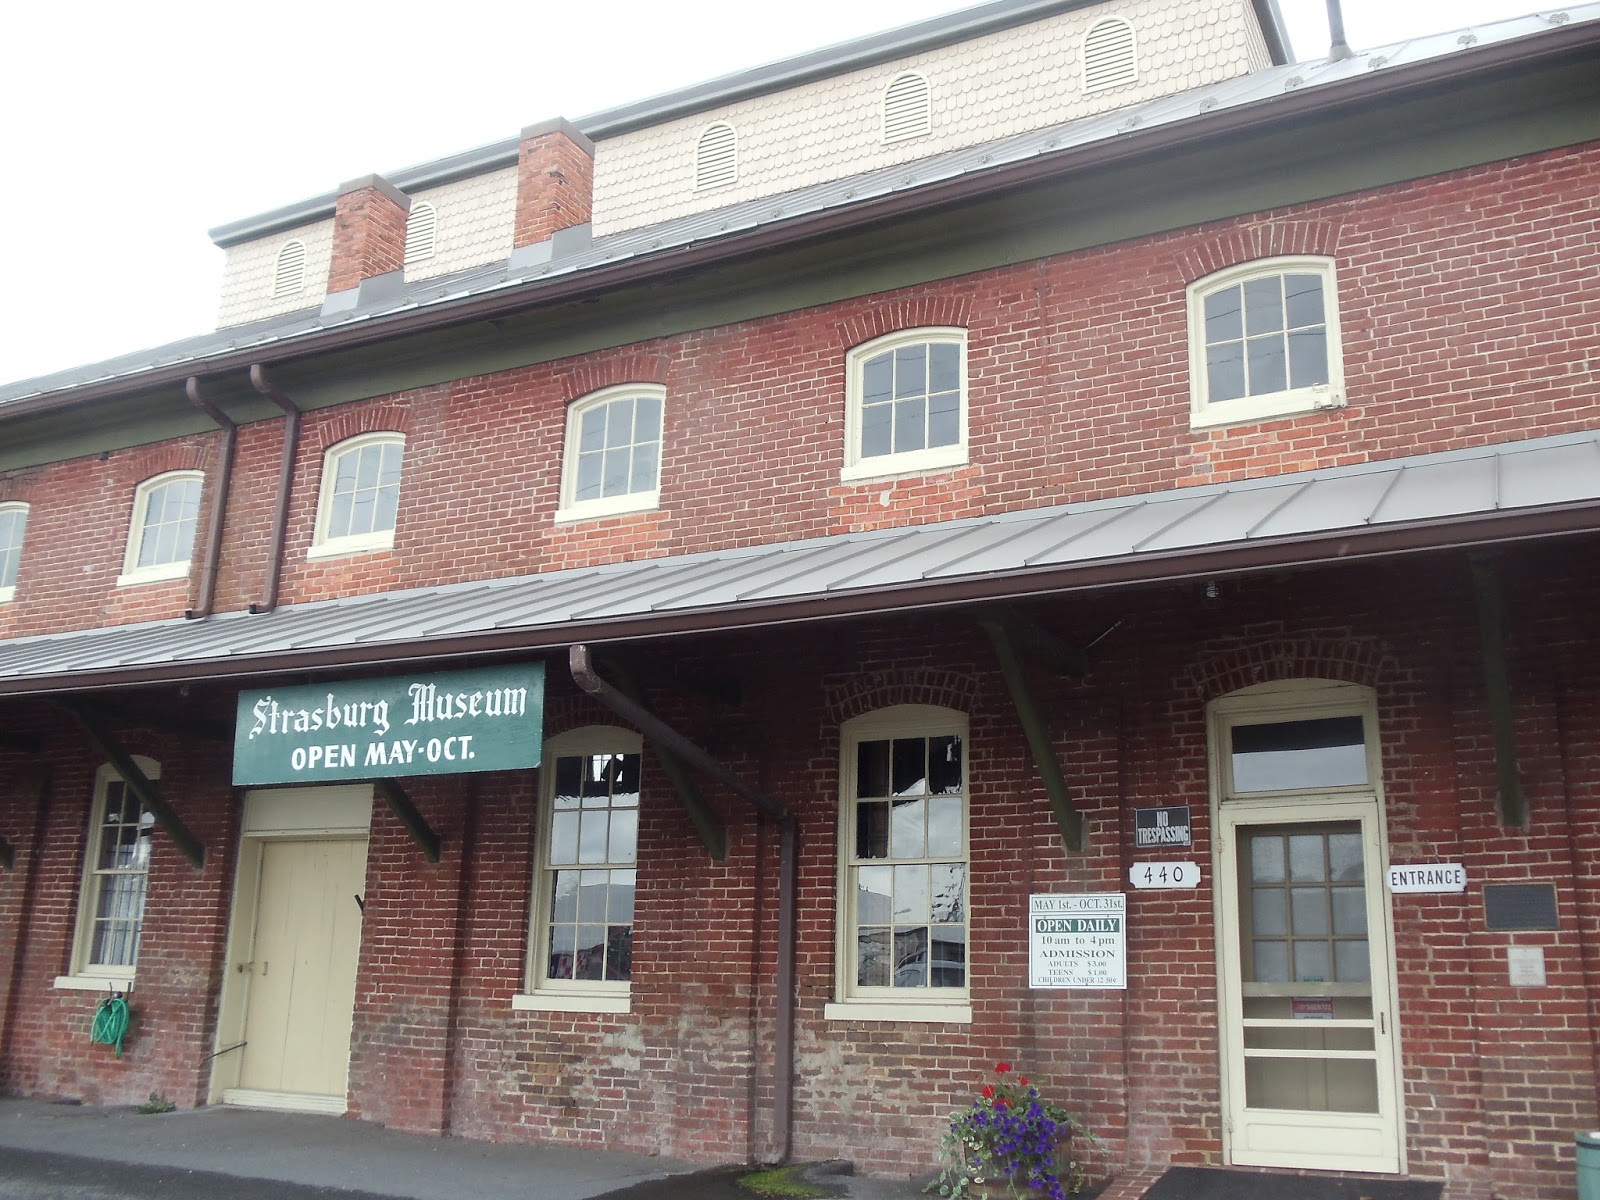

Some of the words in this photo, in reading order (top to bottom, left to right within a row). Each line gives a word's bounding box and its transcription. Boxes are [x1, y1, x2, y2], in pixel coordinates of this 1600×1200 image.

[249, 692, 390, 739] Strasburg
[404, 682, 527, 725] Museum
[291, 744, 356, 770] OPEN
[1156, 811, 1169, 827] NO
[1138, 825, 1189, 844] TRESPASSING
[1144, 866, 1184, 884] 440
[1391, 869, 1461, 886] ENTRANCE
[1034, 900, 1055, 910] MAY
[1079, 898, 1102, 909] OCT.
[1037, 919, 1072, 932] OPEN
[1077, 919, 1117, 932] DAILY
[1040, 950, 1115, 958] ADMISSION
